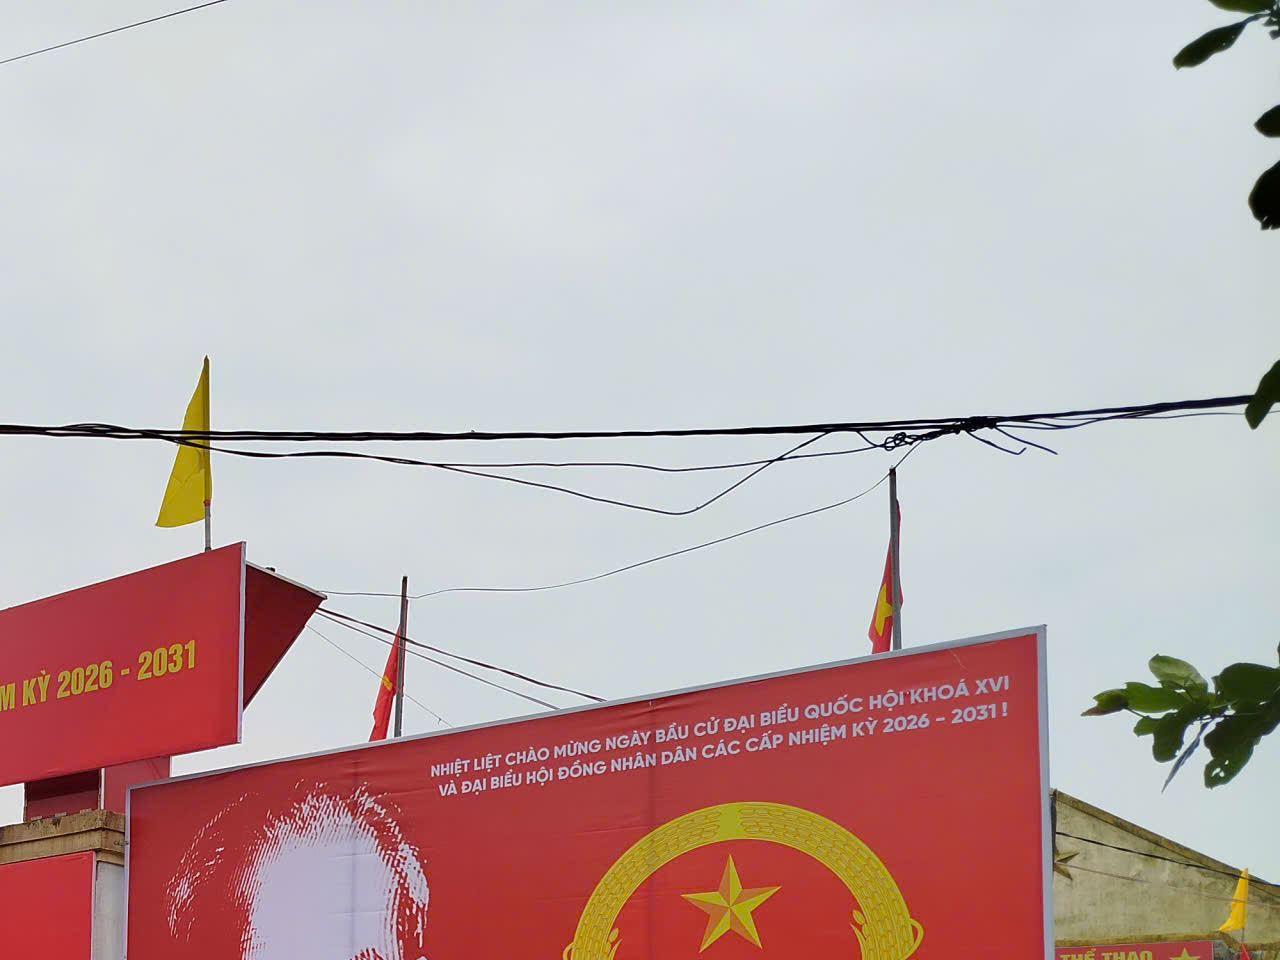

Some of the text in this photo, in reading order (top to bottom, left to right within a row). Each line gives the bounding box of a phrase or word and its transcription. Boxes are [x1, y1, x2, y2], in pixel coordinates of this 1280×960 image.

[22, 670, 51, 706] KỲ
[56, 660, 113, 699] 2026
[121, 667, 130, 676] -
[137, 640, 196, 680] 2031
[430, 675, 1010, 777] NHIỆT LIỆT CHÀO MỪNG NGÀY BẦU CỬ ĐẠI BIỂU QUỐC HỘI KHOÁ XVI
[438, 782, 458, 797] VÀ
[460, 779, 486, 795] ĐẠI
[490, 768, 522, 789] BIỂU
[526, 765, 553, 786] HỘI
[557, 759, 606, 779] ĐỒNG
[610, 752, 657, 772] NHÂN
[661, 745, 697, 765] DÂN
[701, 740, 741, 759] CÁC
[745, 731, 783, 752] CẤP
[788, 724, 847, 745] NHIỆM
[852, 716, 878, 738] KỲ
[882, 714, 930, 733] 2026
